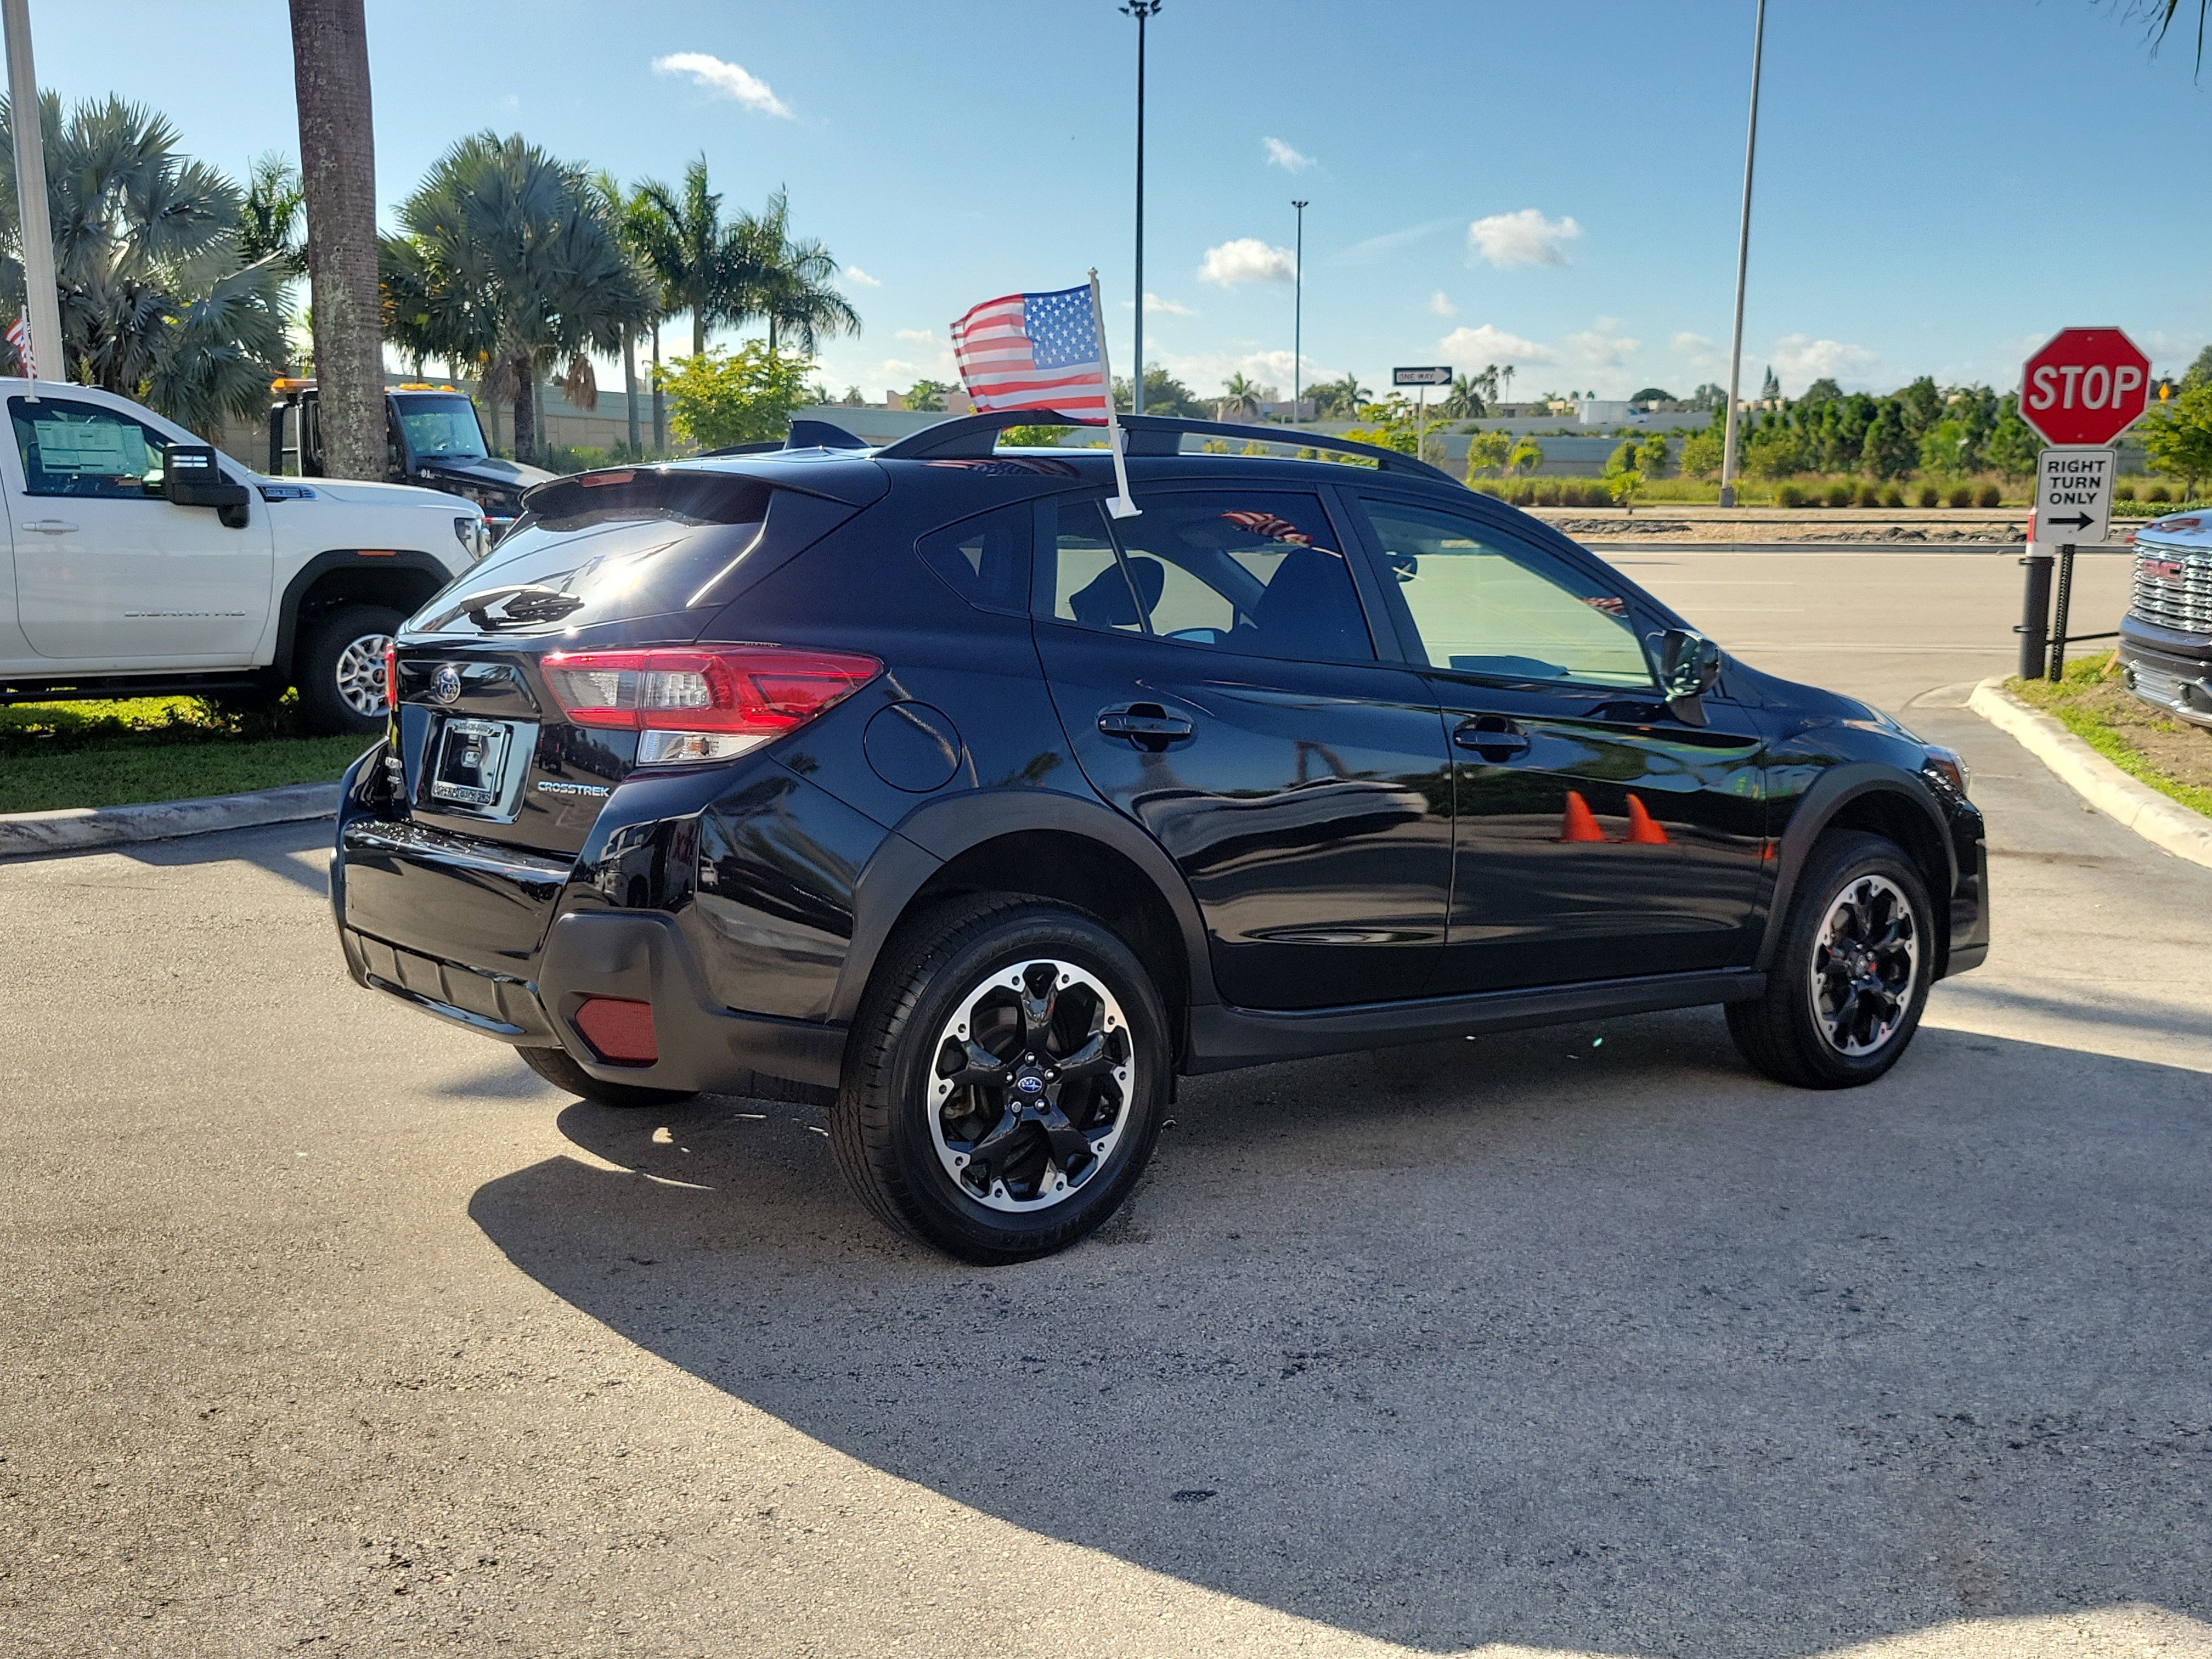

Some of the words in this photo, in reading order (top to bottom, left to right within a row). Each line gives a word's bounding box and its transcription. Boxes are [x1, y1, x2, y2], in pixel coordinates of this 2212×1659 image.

[1398, 373, 1415, 381] ONE
[1418, 373, 1435, 381] WAY
[2029, 365, 2142, 410] STOP
[2047, 460, 2106, 473] RIGHT
[2050, 477, 2101, 489] TURN
[2049, 492, 2097, 505] ONLY
[538, 781, 611, 798] CROSSTREK
